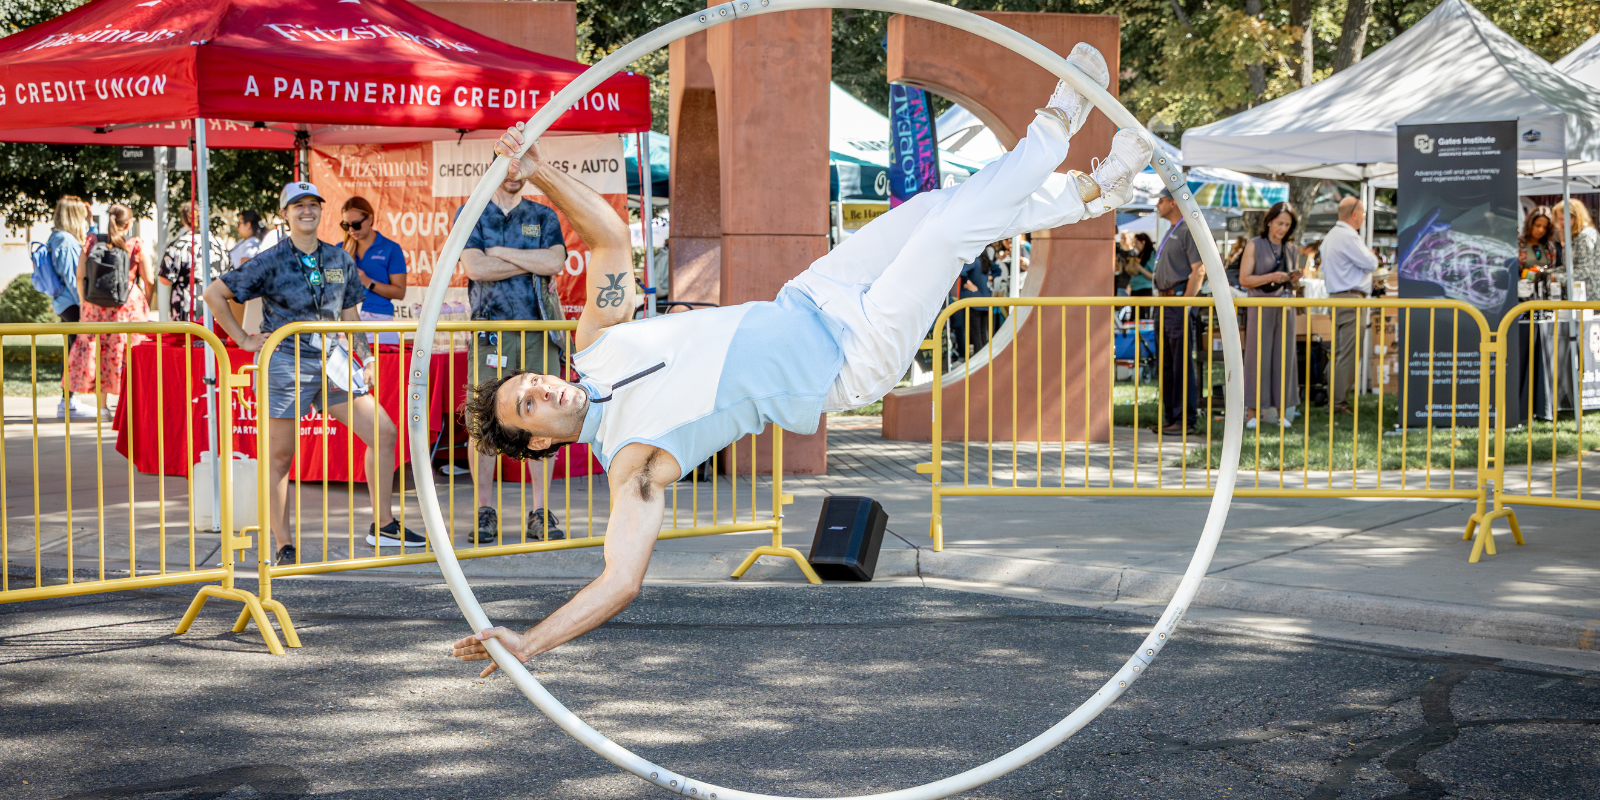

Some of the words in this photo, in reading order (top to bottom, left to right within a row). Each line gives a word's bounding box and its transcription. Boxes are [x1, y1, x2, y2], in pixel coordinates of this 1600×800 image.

[263, 18, 478, 53] Fitzsimons
[15, 80, 86, 104] CREDIT
[95, 74, 167, 100] UNION
[244, 75, 260, 97] A
[273, 77, 441, 106] PARTNERING
[454, 86, 540, 109] CREDIT
[550, 91, 620, 111] ION
[1438, 137, 1461, 145] Gates
[1463, 136, 1496, 144] Institute
[338, 154, 429, 178] Fitzsimons
[581, 158, 619, 173] AUTO
[387, 212, 449, 236] YOUR
